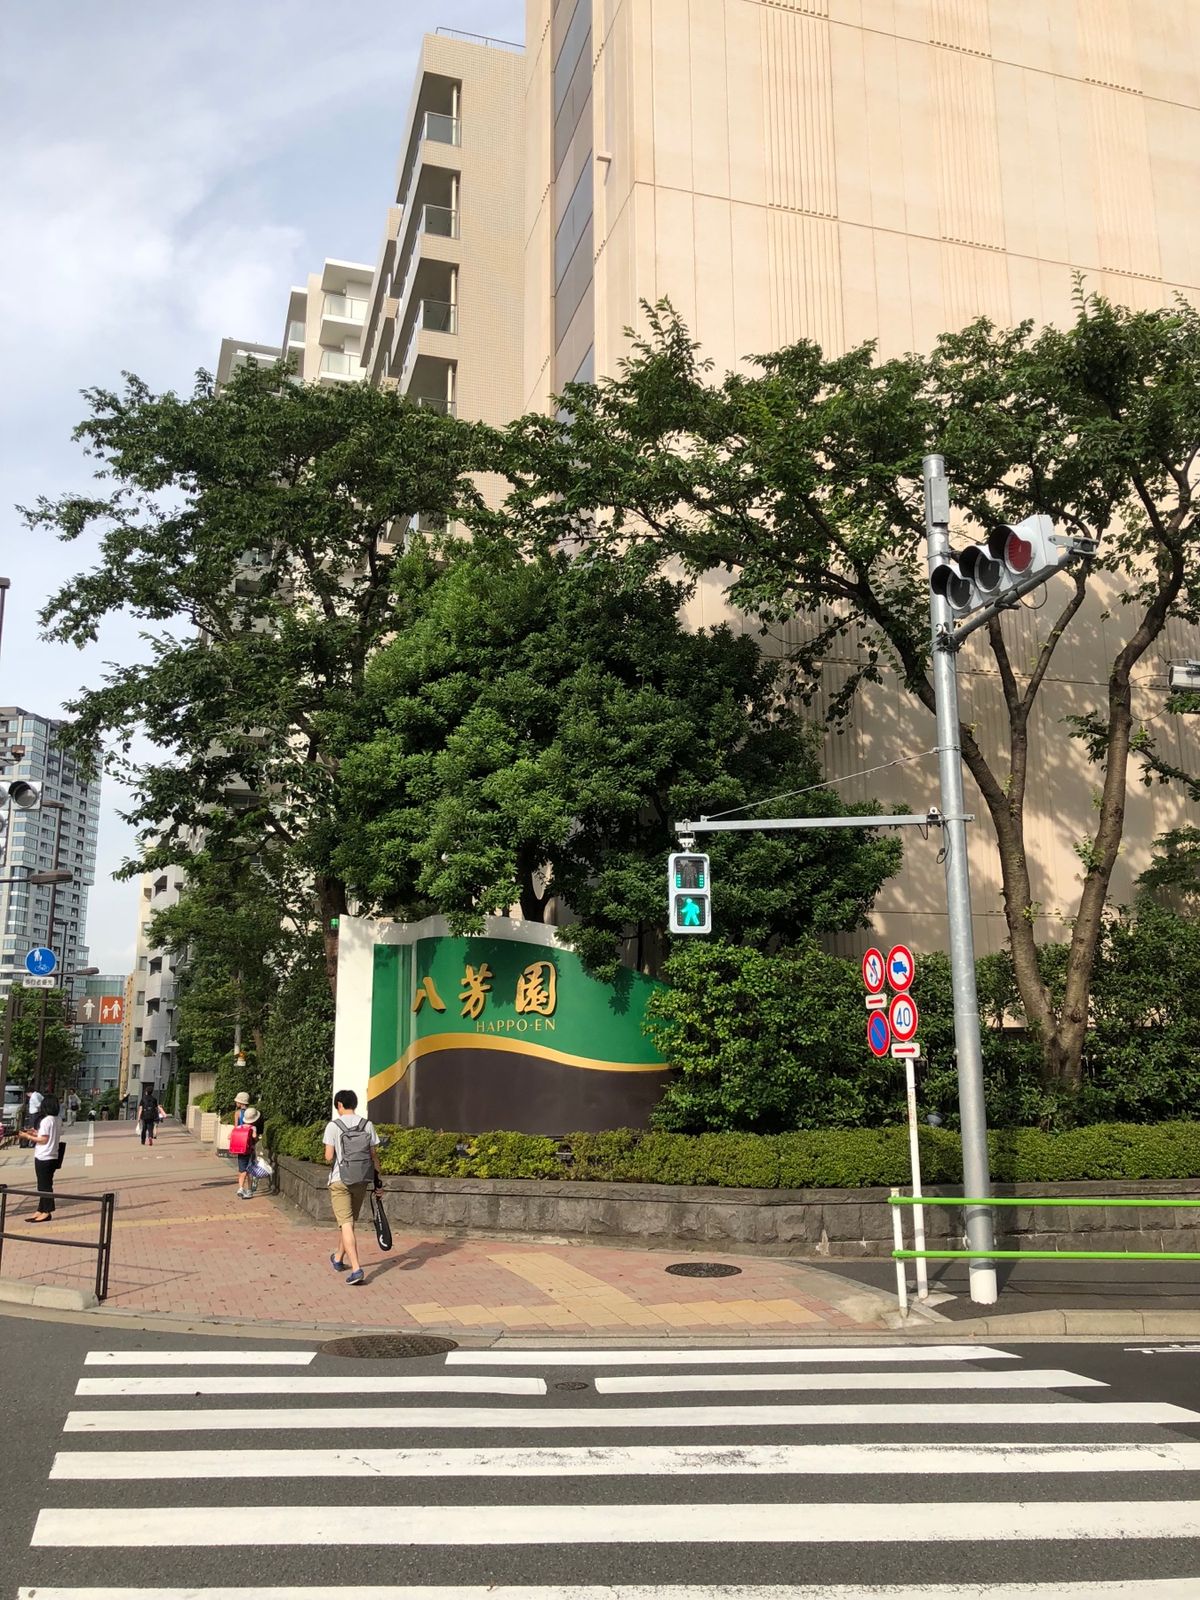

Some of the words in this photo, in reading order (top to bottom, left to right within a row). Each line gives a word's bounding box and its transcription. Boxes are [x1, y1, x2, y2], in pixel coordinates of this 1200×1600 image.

[412, 961, 556, 1019] 八芳園
[476, 1019, 556, 1032] HAPPO-EN
[896, 1007, 911, 1027] 40
